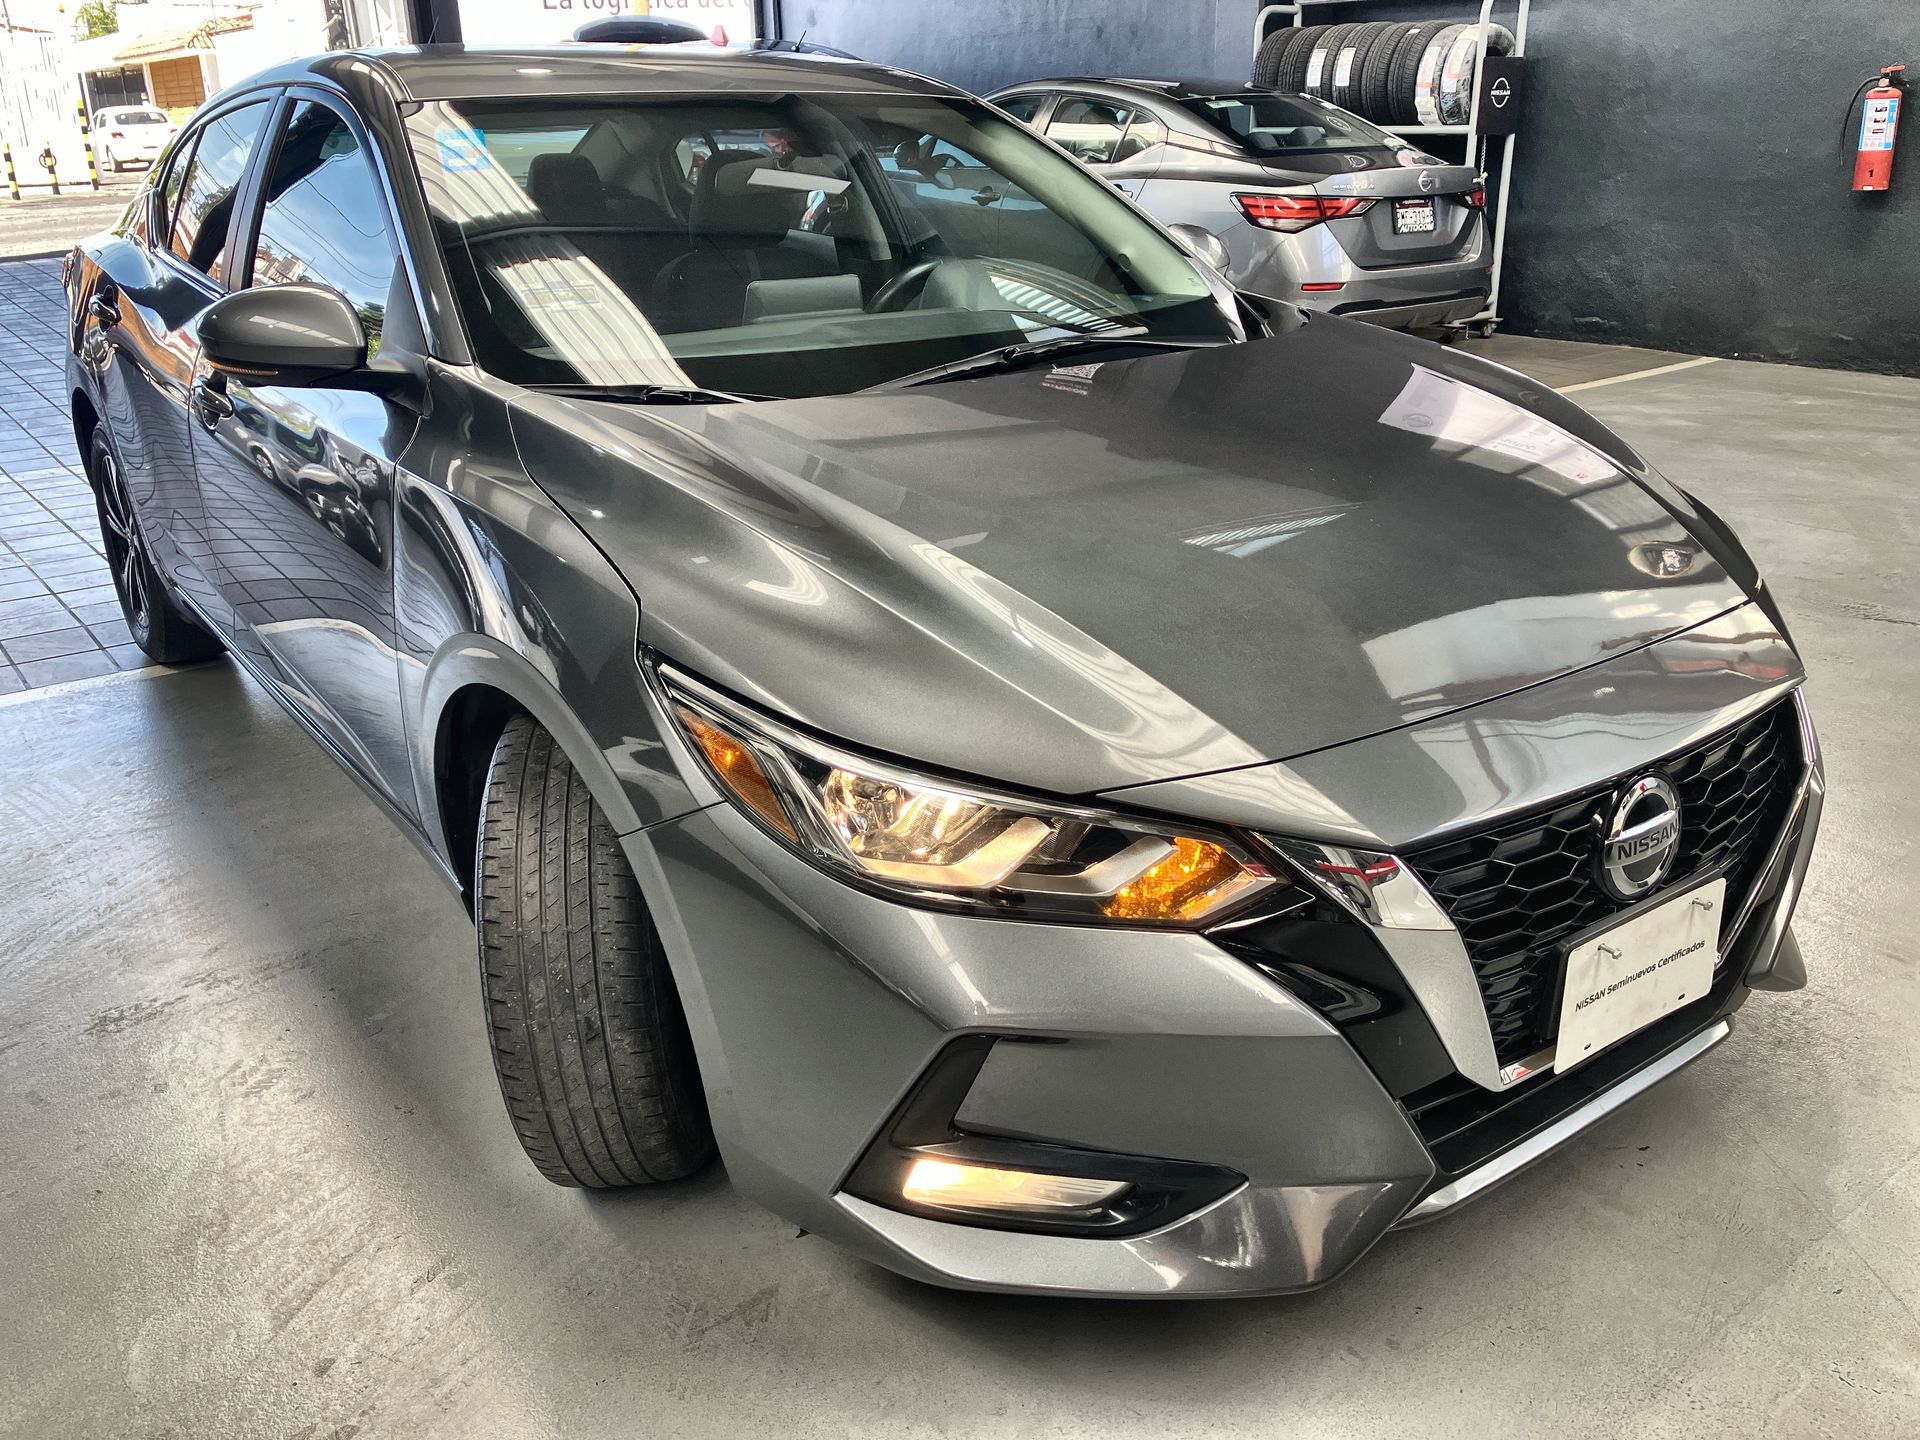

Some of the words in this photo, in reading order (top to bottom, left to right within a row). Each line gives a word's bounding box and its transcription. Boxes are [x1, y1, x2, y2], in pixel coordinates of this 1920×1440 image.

[1867, 169, 1874, 178] 1
[1617, 817, 1678, 861] NISSAN
[1575, 988, 1607, 1012] NISSAN
[1606, 963, 1657, 995] Seminuevos
[1657, 940, 1706, 968] Certificados
